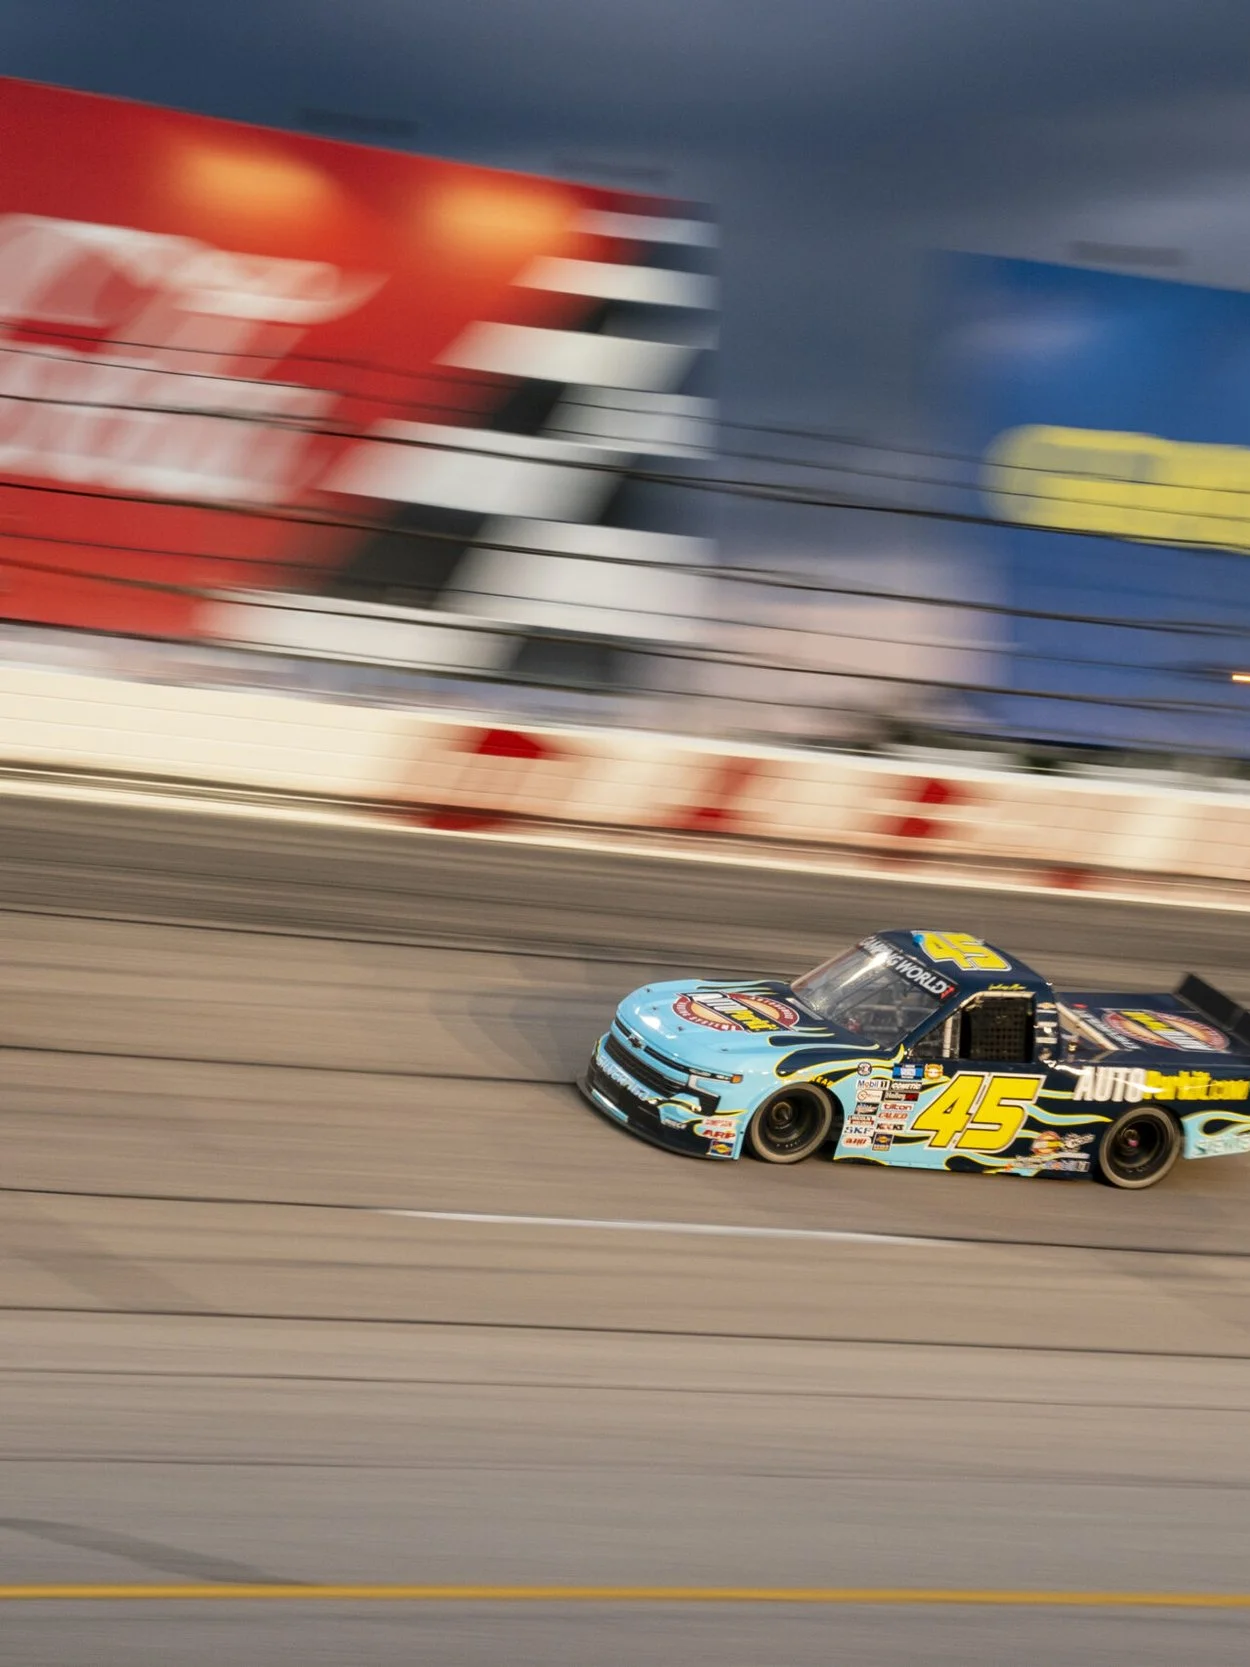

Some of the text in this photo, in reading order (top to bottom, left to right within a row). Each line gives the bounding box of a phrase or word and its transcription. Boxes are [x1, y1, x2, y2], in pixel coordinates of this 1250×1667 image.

[912, 931, 1012, 971] 45
[897, 959, 951, 995] WORLD
[857, 1080, 879, 1089] Mobil
[911, 1072, 1045, 1153] 45
[702, 1129, 735, 1139] ARP
[844, 1126, 873, 1134] SKF
